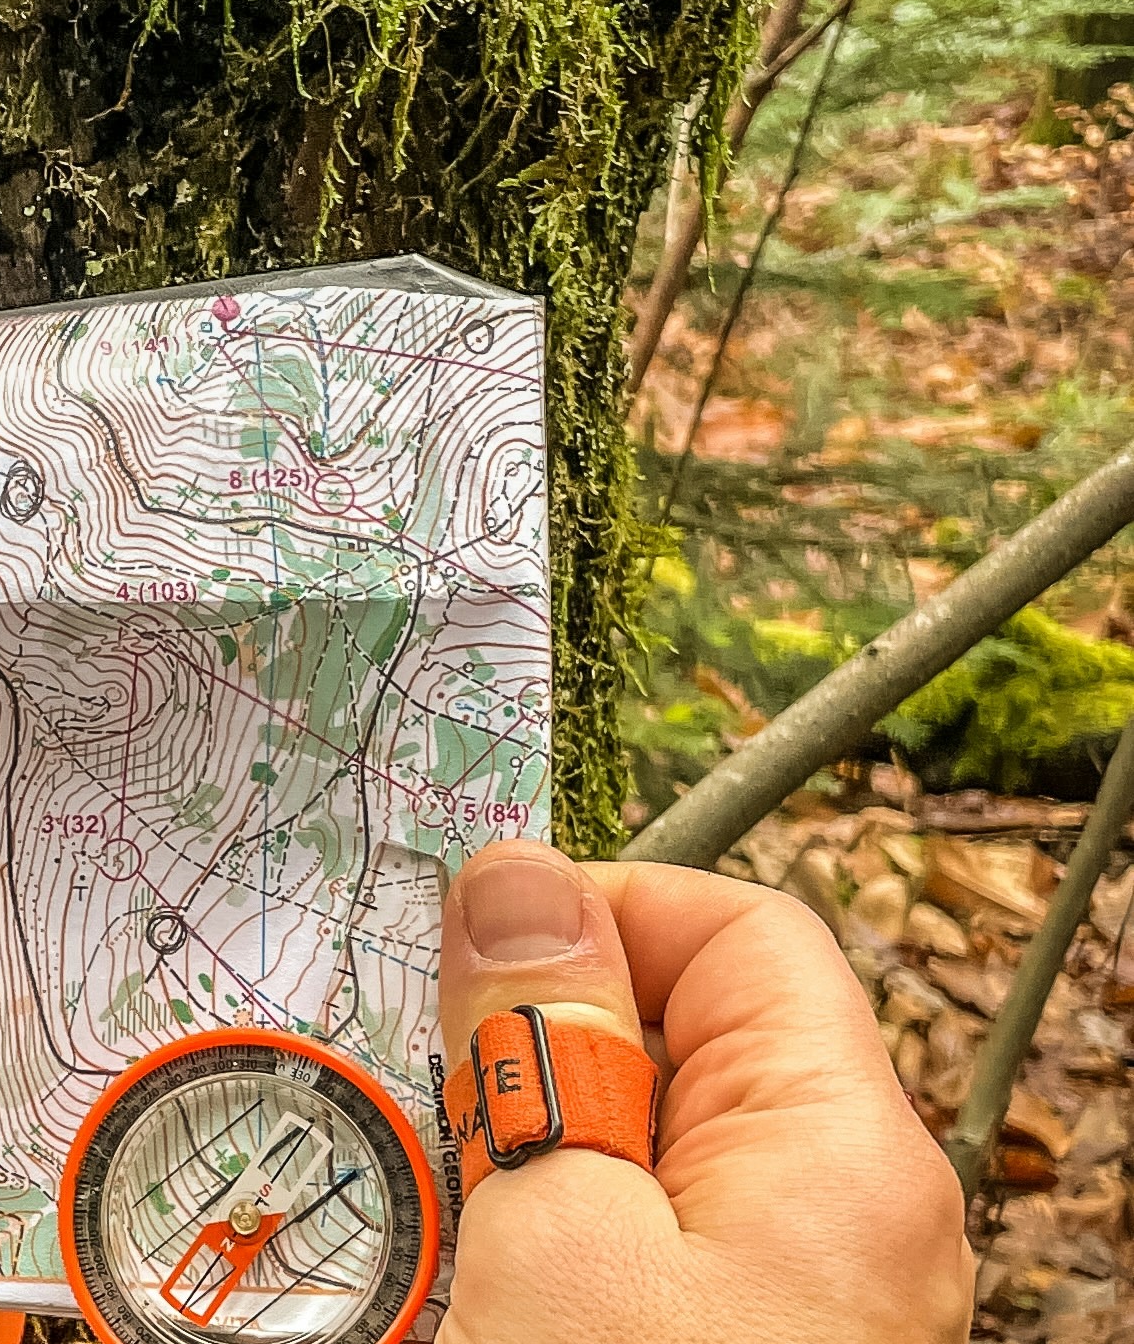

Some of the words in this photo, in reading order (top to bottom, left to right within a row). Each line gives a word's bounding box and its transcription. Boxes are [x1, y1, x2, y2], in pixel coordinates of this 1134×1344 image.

[100, 340, 113, 356] 9
[122, 336, 180, 359] (141)
[229, 470, 243, 490] 8
[251, 467, 311, 493] (125)
[116, 582, 131, 601] 4
[139, 581, 197, 606] (103)
[41, 814, 54, 834] 3
[63, 814, 107, 839] (32)
[463, 803, 476, 823] 5
[485, 802, 529, 829] (84)
[186, 1064, 208, 1077] 290
[211, 1059, 234, 1071] 300
[290, 1066, 311, 1084] 330
[161, 1072, 183, 1089] 280
[259, 1183, 272, 1197] S
[220, 1237, 236, 1252] N
[92, 1255, 109, 1278] 200
[102, 1280, 118, 1302] 190
[116, 1304, 135, 1326] 180
